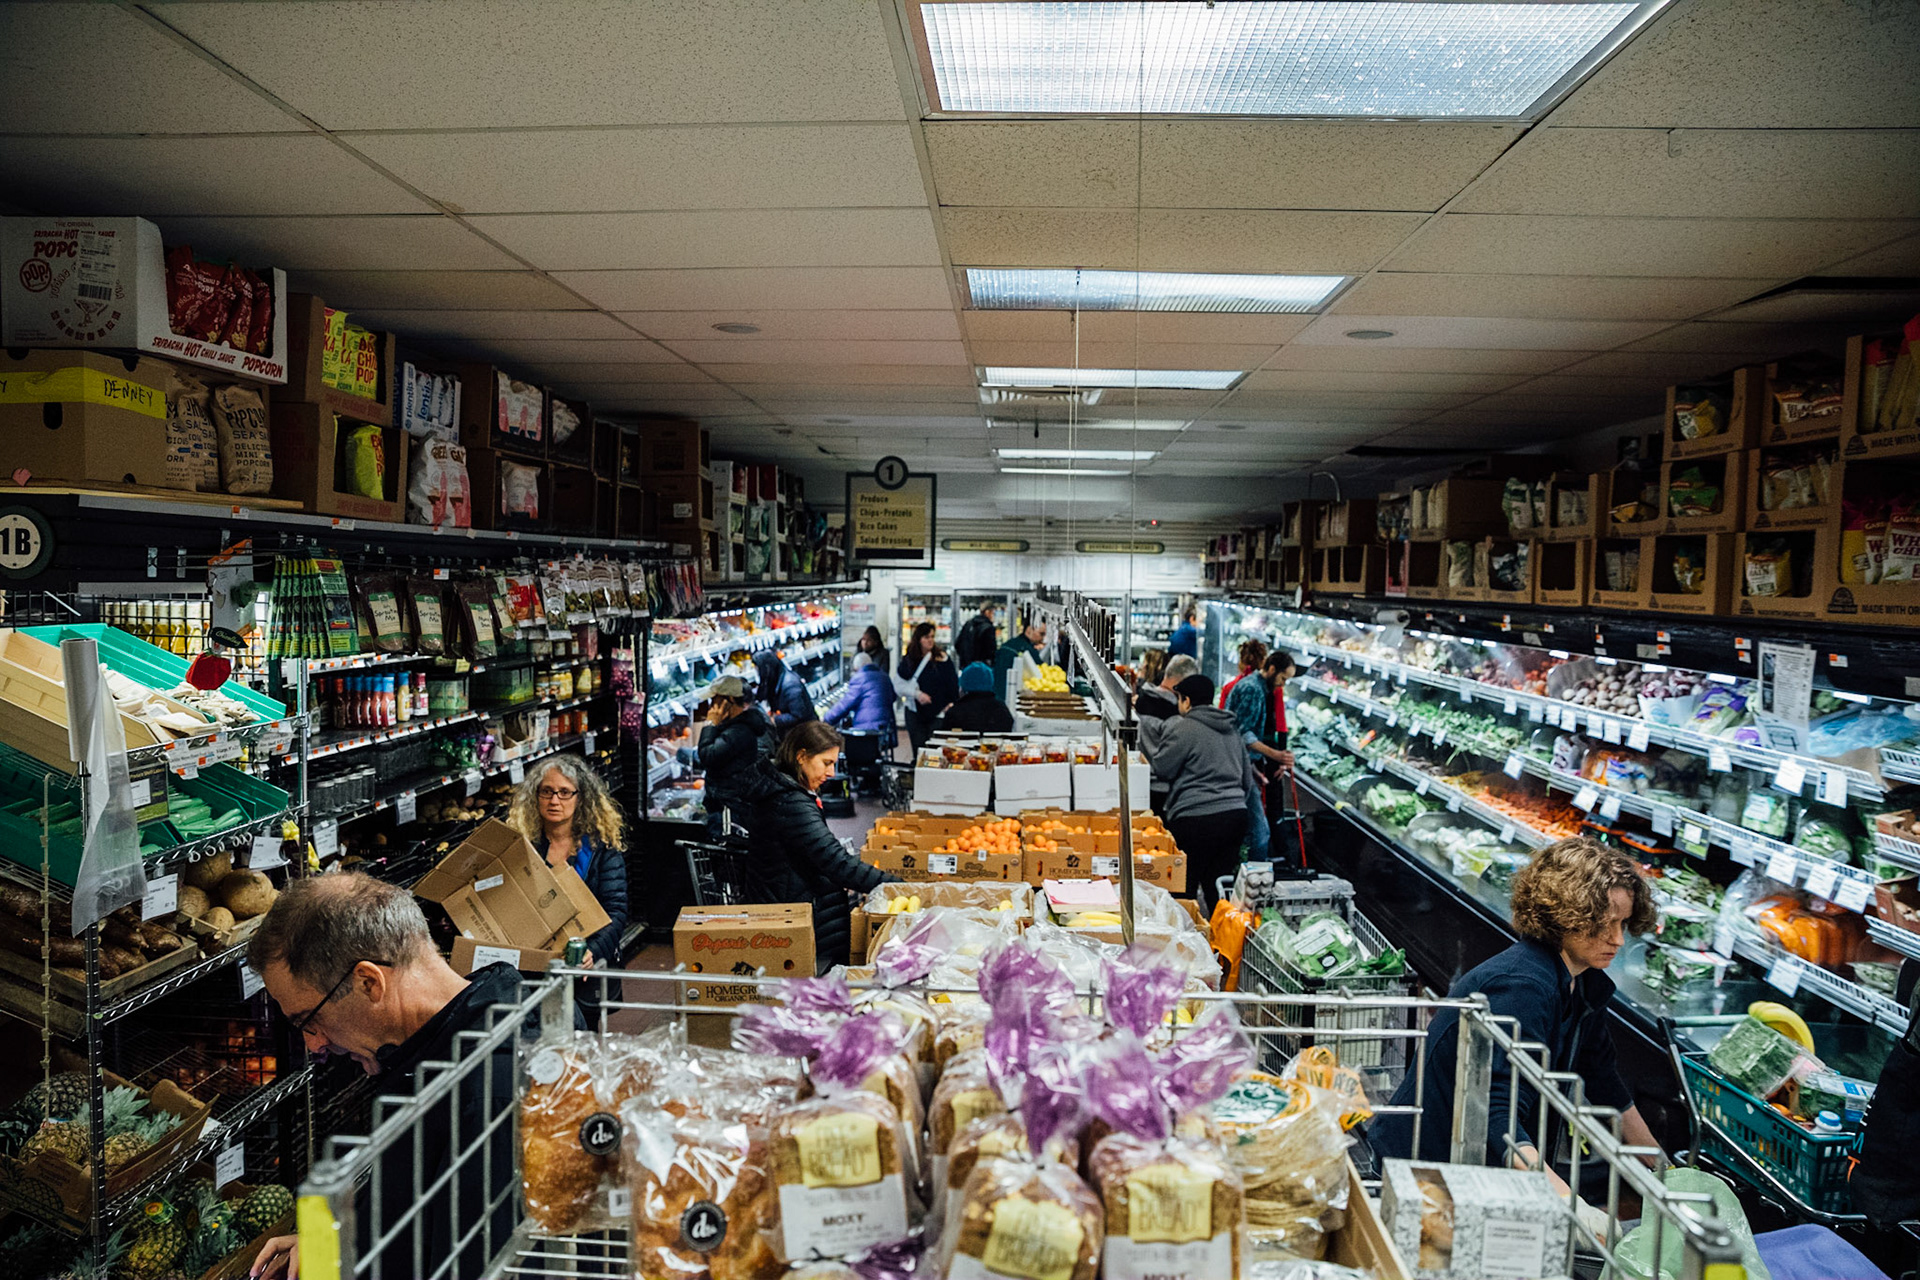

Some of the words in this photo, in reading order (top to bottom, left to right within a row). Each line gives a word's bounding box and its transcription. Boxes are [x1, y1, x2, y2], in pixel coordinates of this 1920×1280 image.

[64, 229, 80, 240] HOT
[152, 336, 184, 352] SRIRACHA
[183, 341, 202, 358] HOT
[200, 347, 217, 360] CHILI
[217, 352, 236, 365] SAUCE
[241, 356, 284, 378] POPCORN
[356, 367, 375, 385] POP
[103, 378, 154, 407] DENNEY
[233, 430, 256, 440] SEA
[1870, 436, 1893, 449] MADE
[1894, 433, 1916, 446] WITH
[886, 463, 895, 481] 1
[860, 494, 889, 503] Produce
[860, 522, 875, 531] Rice
[876, 522, 898, 531] Cakes
[0, 527, 31, 556] 1B
[860, 536, 880, 545] Salad
[880, 536, 913, 547] Dressing
[1861, 604, 1884, 614] MADE
[1885, 604, 1907, 615] WITH
[691, 932, 749, 956] Organic
[749, 932, 793, 950] Citrus
[822, 1213, 864, 1227] MOXY
